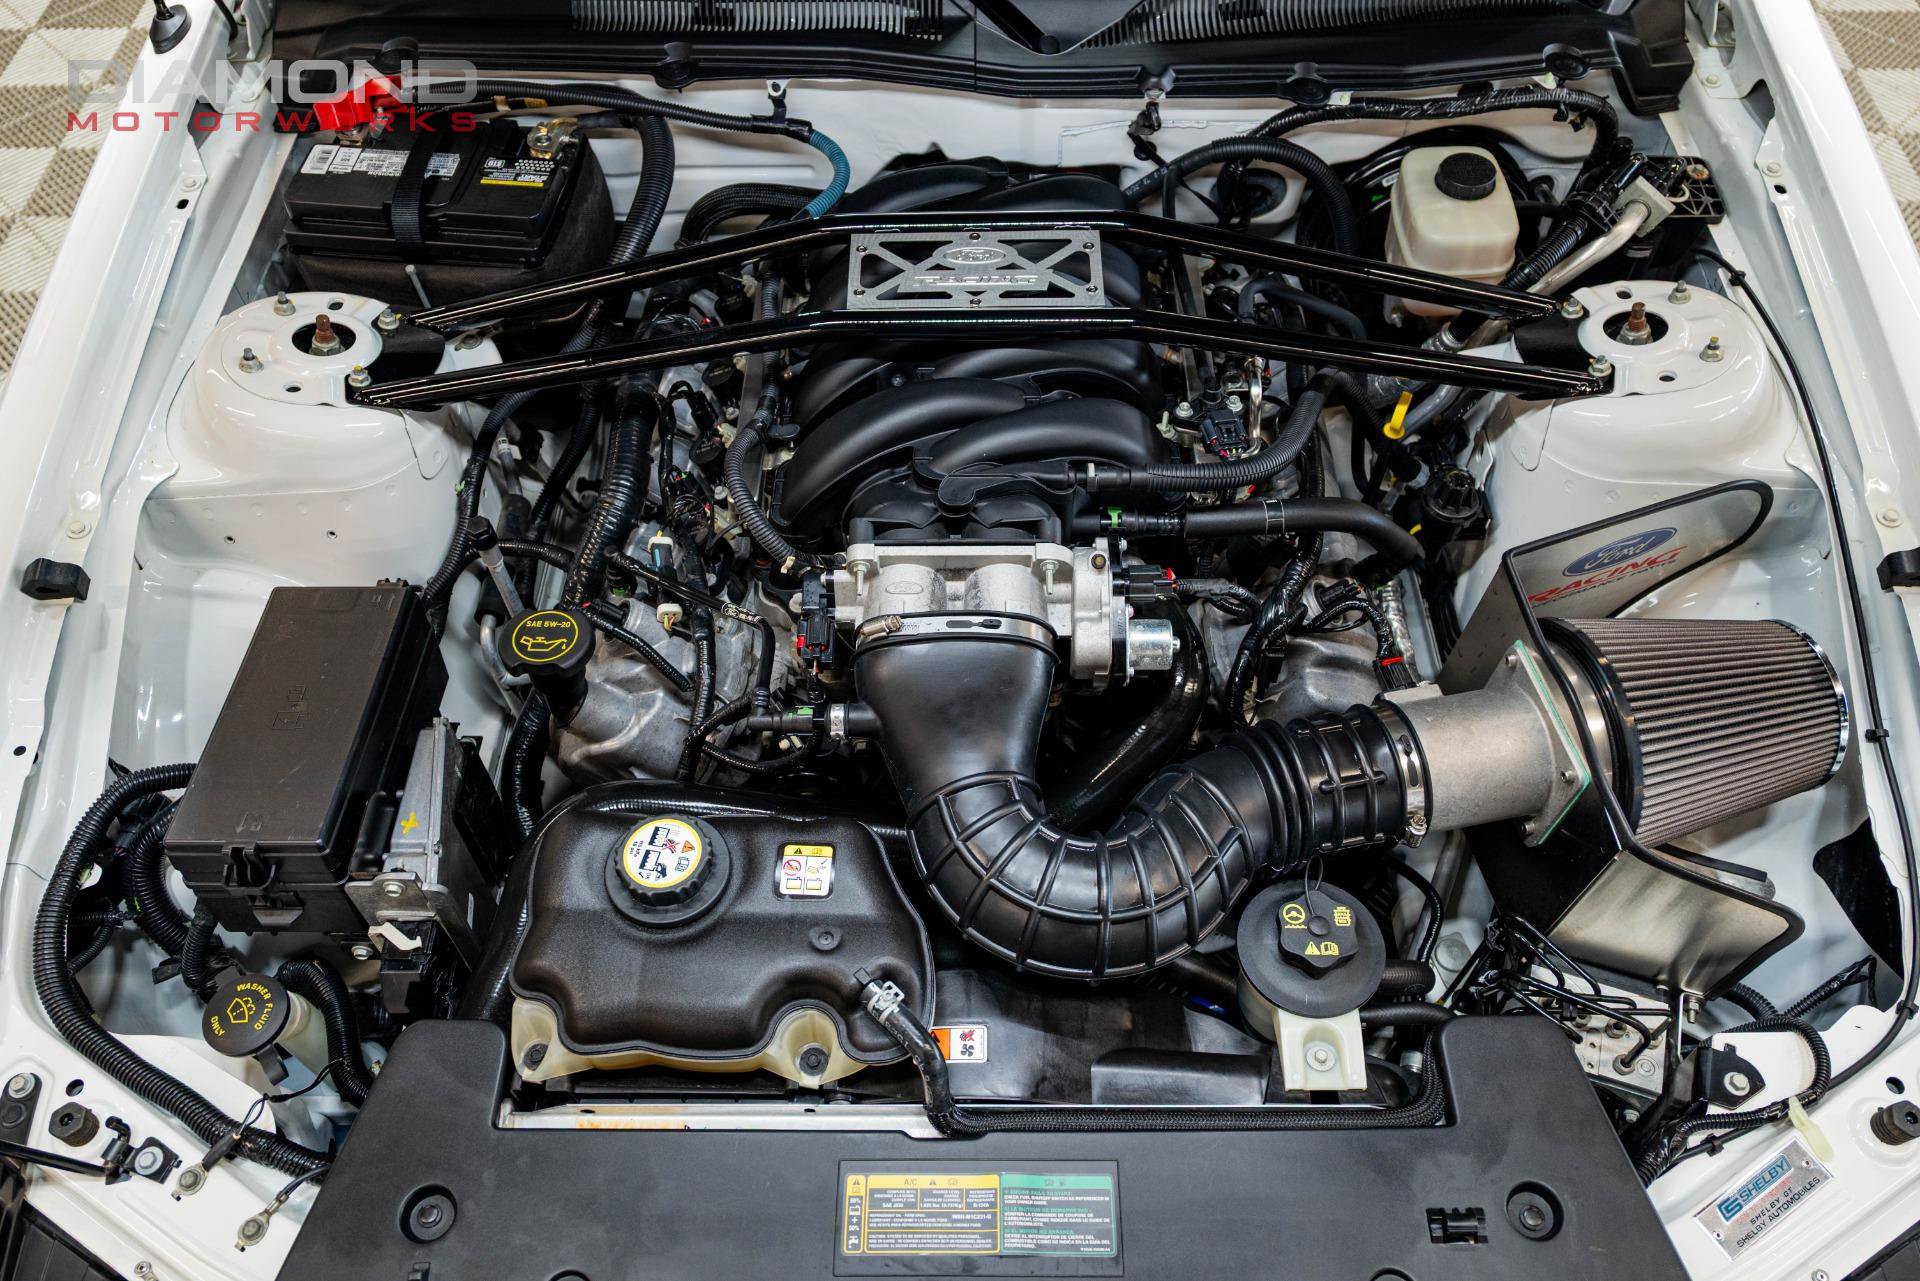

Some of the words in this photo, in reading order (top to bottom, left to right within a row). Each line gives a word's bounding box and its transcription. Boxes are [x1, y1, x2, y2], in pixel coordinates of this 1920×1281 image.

[1584, 537, 1656, 569] Ford
[1527, 545, 1688, 602] RACING
[525, 620, 542, 628] SAE
[543, 620, 571, 628] 5W-20
[211, 1015, 225, 1036] ONLY
[236, 983, 272, 1000] WASHER
[254, 1003, 273, 1030] FLUID
[904, 1178, 917, 1186] A/C
[1739, 1159, 1788, 1202] SHELBY
[1736, 1221, 1768, 1248] SHELBY
[1768, 1176, 1821, 1222] AUTOMOBILES
[1750, 1198, 1782, 1225] SHELBY
[1783, 1186, 1794, 1198] GT
